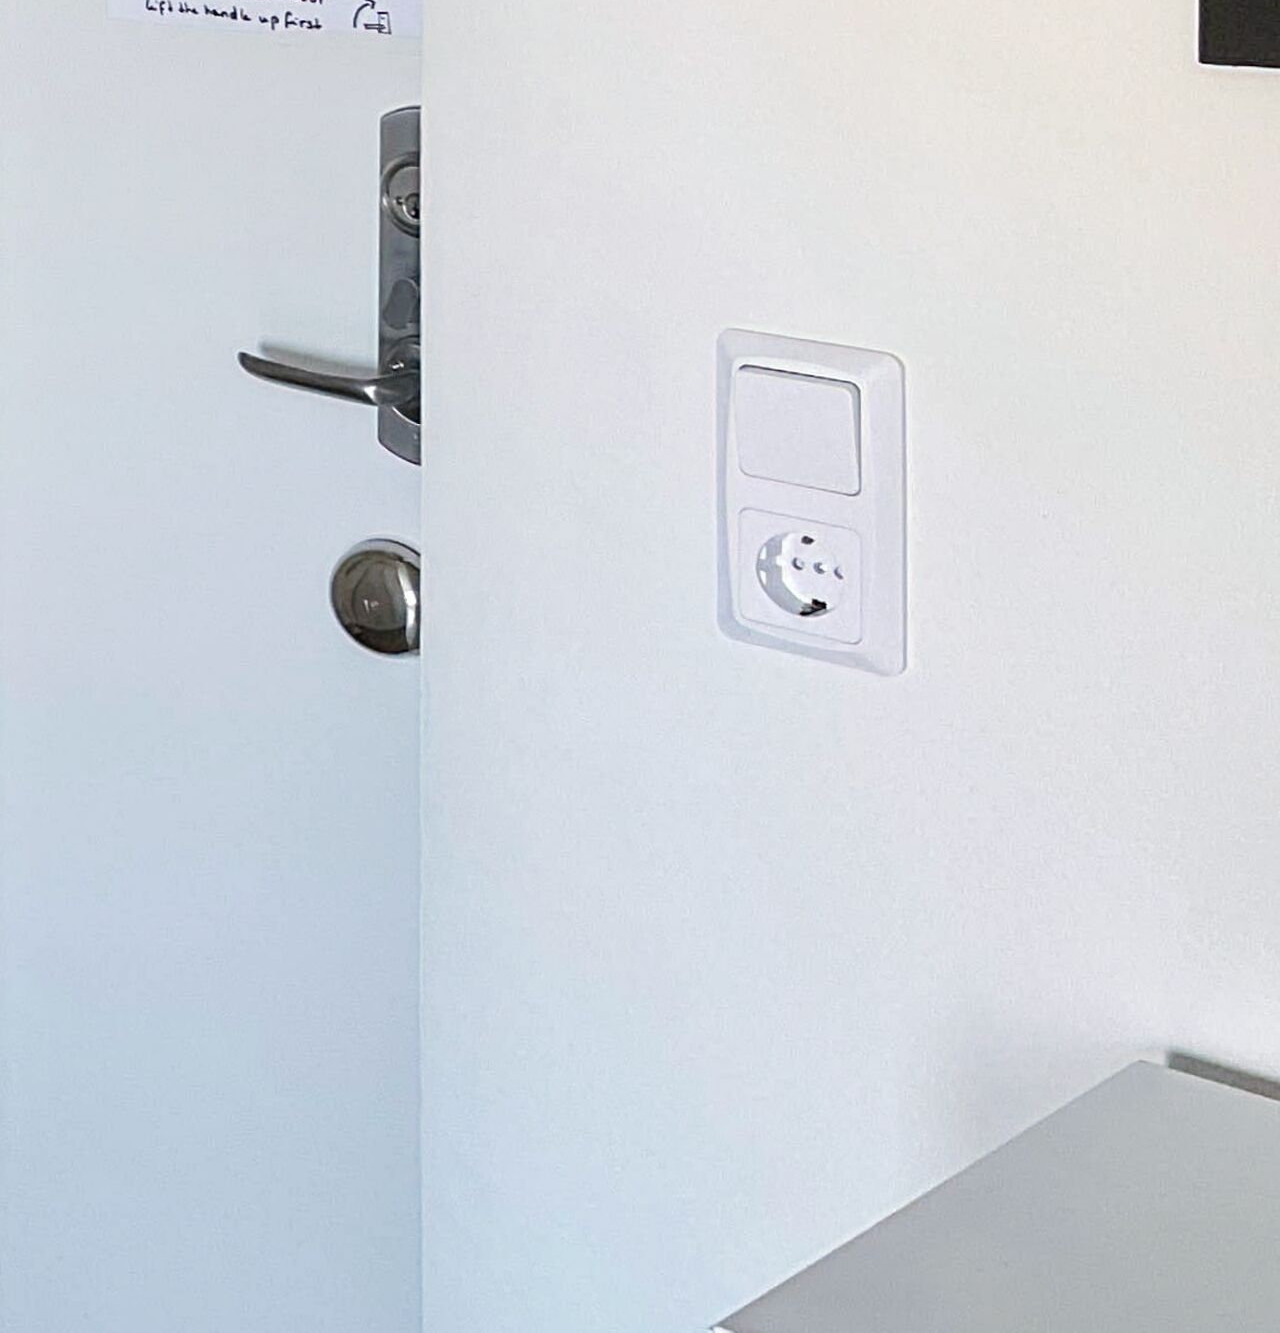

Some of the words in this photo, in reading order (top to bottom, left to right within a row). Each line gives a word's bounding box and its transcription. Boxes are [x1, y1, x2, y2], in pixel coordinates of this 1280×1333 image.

[178, 2, 199, 15] the
[204, 4, 252, 21] handle
[258, 15, 280, 30] up
[284, 12, 323, 30] first
